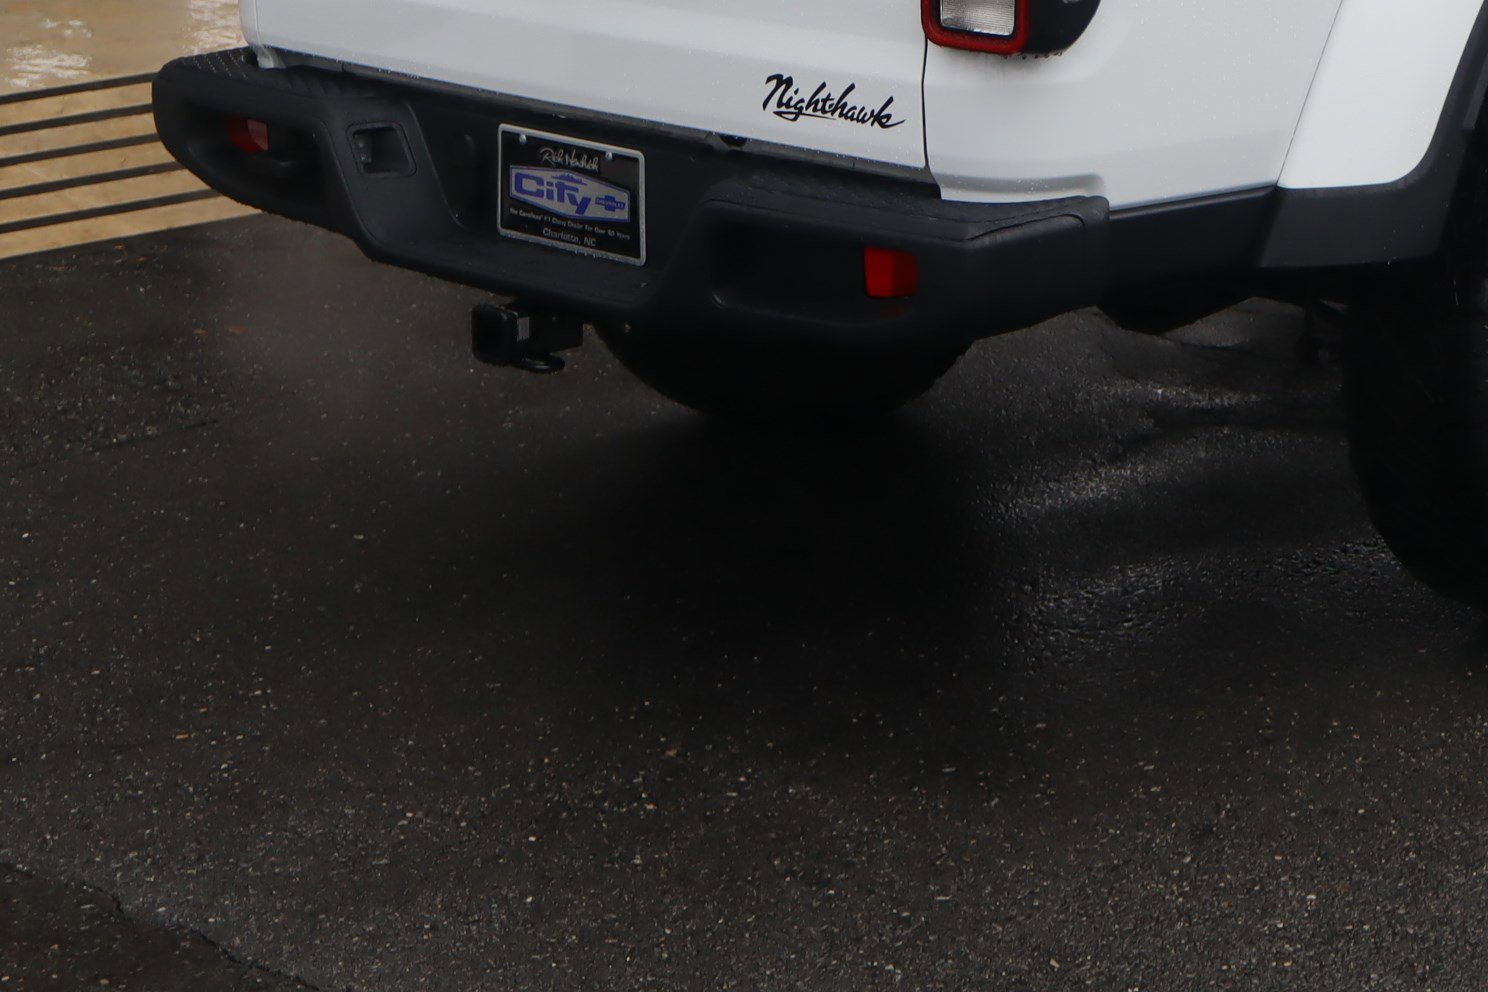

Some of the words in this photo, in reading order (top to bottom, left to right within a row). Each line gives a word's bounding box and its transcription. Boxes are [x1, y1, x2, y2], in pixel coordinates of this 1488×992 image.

[762, 73, 906, 129] Nighthawk
[514, 171, 591, 216] City
[583, 237, 597, 247] NC
